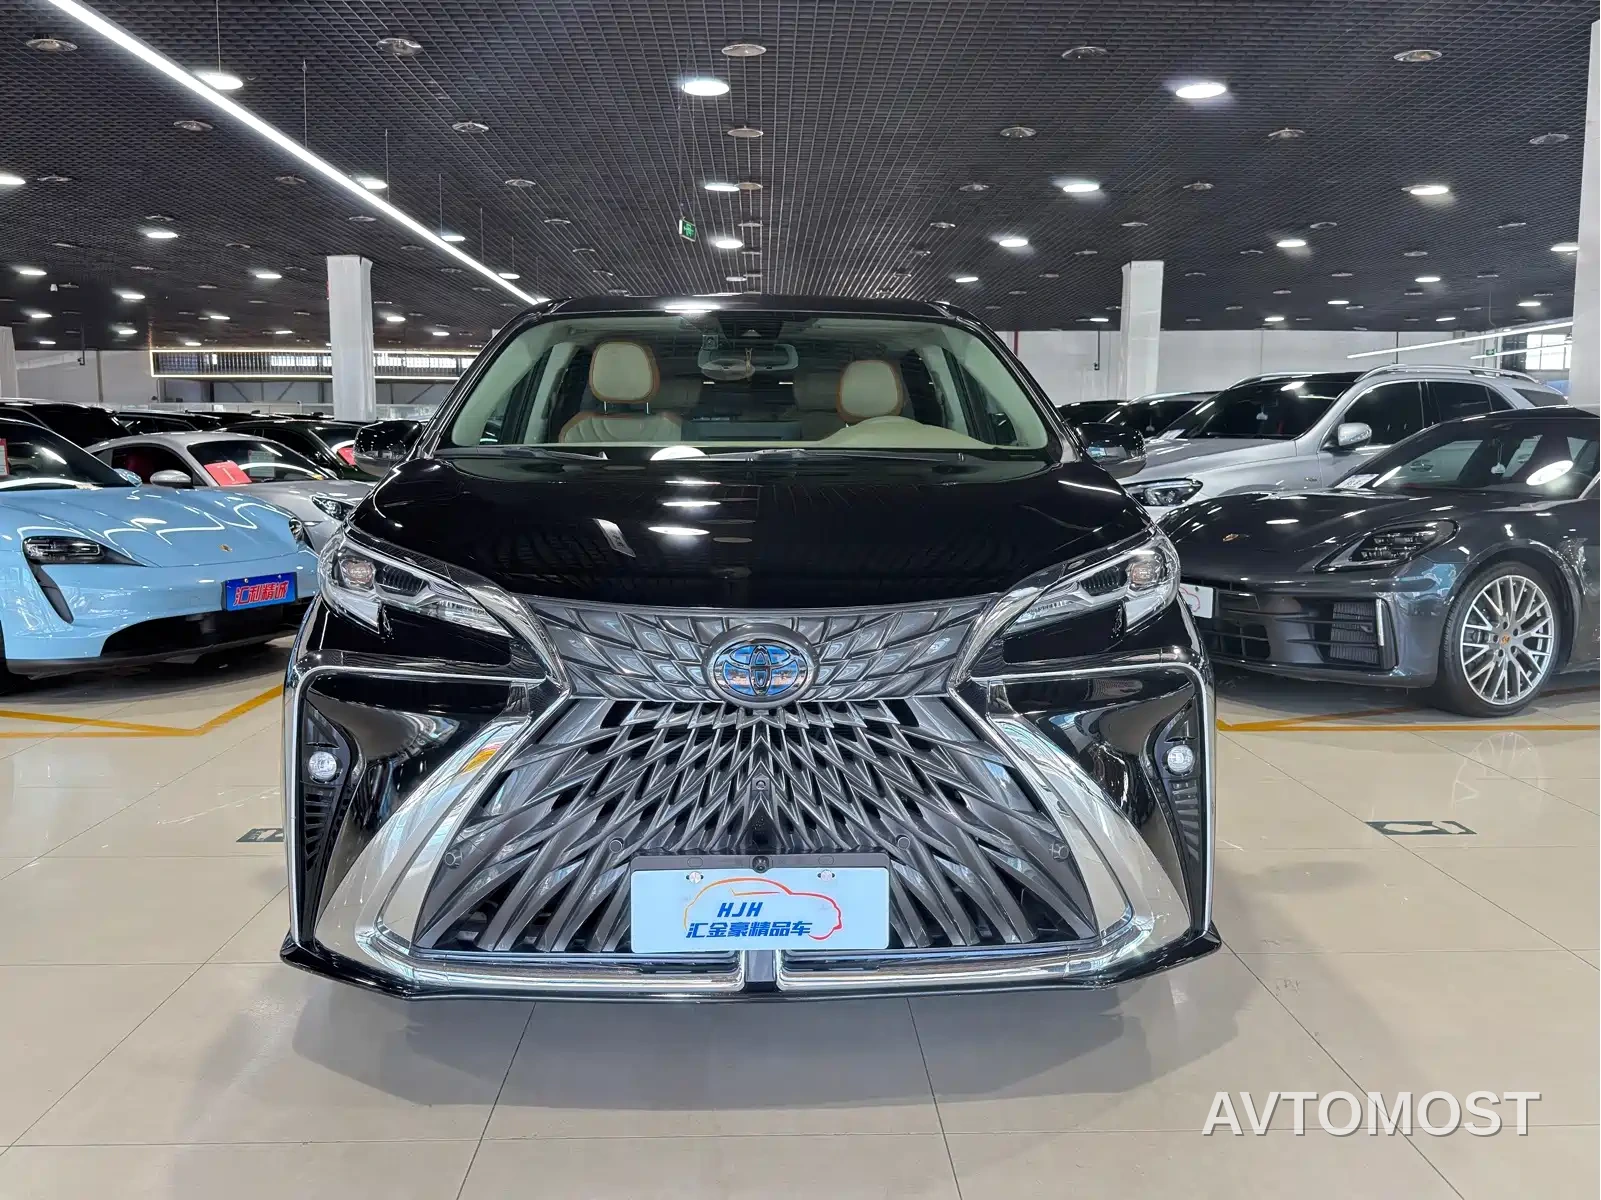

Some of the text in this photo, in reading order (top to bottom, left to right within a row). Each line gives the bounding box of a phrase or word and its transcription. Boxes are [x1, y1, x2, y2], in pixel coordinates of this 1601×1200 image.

[716, 902, 763, 918] HJH
[686, 921, 813, 938] 汇金豪精品车
